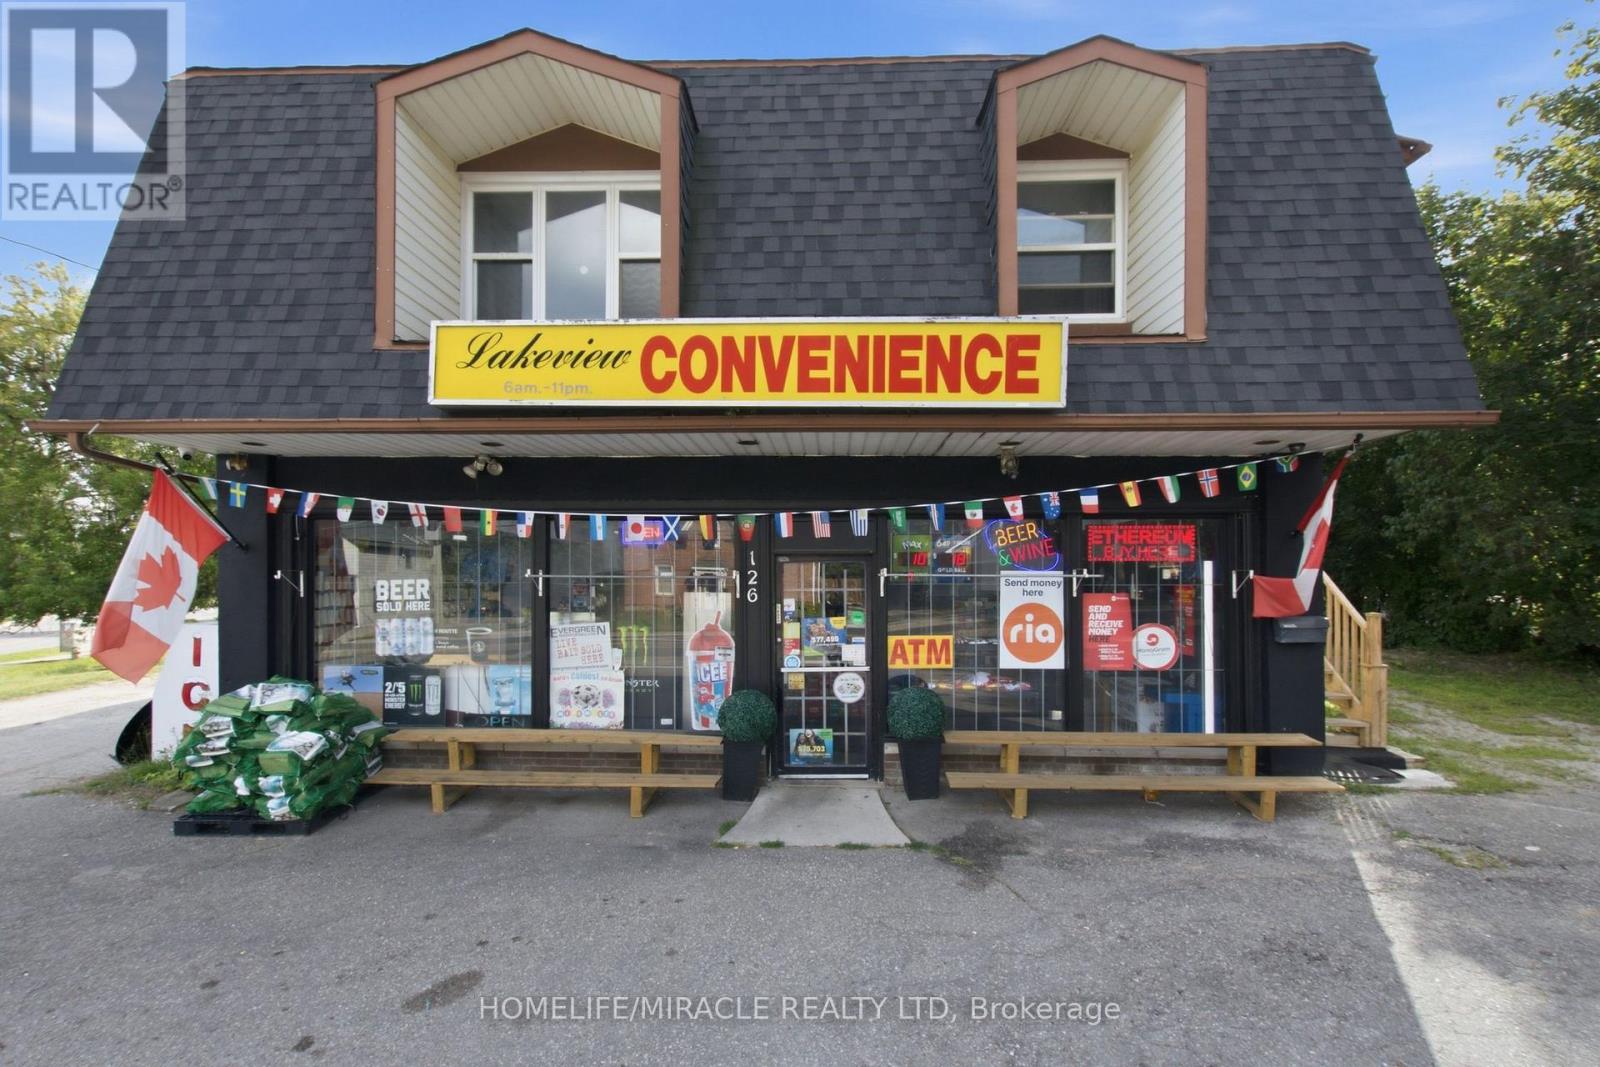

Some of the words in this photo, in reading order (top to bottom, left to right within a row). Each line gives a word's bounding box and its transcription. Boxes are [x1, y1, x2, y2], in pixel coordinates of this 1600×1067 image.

[455, 331, 632, 369] Lakeview
[641, 333, 1041, 395] CONVENIENCE
[995, 522, 1038, 546] BEER
[1091, 528, 1193, 545] ETHEREUM
[998, 549, 1011, 566] &
[1010, 538, 1056, 565] WINE
[375, 579, 430, 600] BEER
[1004, 579, 1029, 587] Send
[1030, 580, 1062, 589] money
[1022, 589, 1043, 597] here
[376, 601, 402, 612] SOLD
[405, 601, 430, 611] HERE
[1088, 605, 1112, 613] SEND
[550, 624, 607, 638] EVERGREEN
[1010, 613, 1056, 643] ria
[1088, 620, 1123, 628] RECEIVE
[1088, 628, 1118, 636] MONEY
[889, 639, 951, 664] ATM
[697, 662, 727, 682] ICEE
